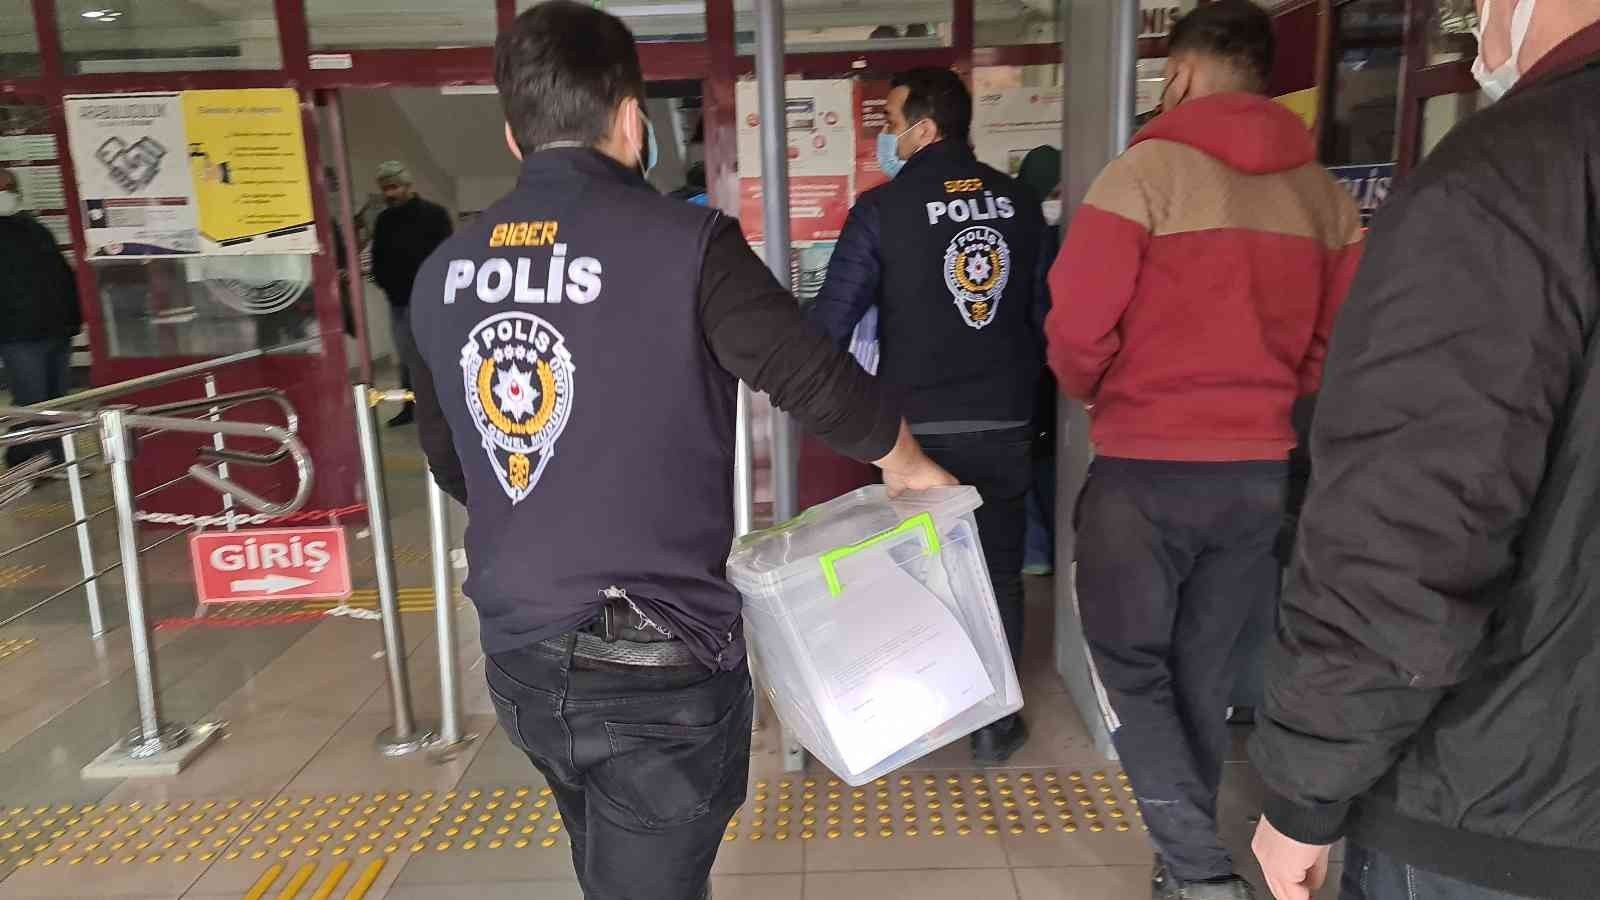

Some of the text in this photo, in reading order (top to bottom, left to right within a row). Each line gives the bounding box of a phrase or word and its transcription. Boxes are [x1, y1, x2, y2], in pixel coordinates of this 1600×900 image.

[926, 190, 1015, 225] POLİS
[444, 243, 602, 304] POLİS
[210, 535, 331, 573] GİRİŞ
